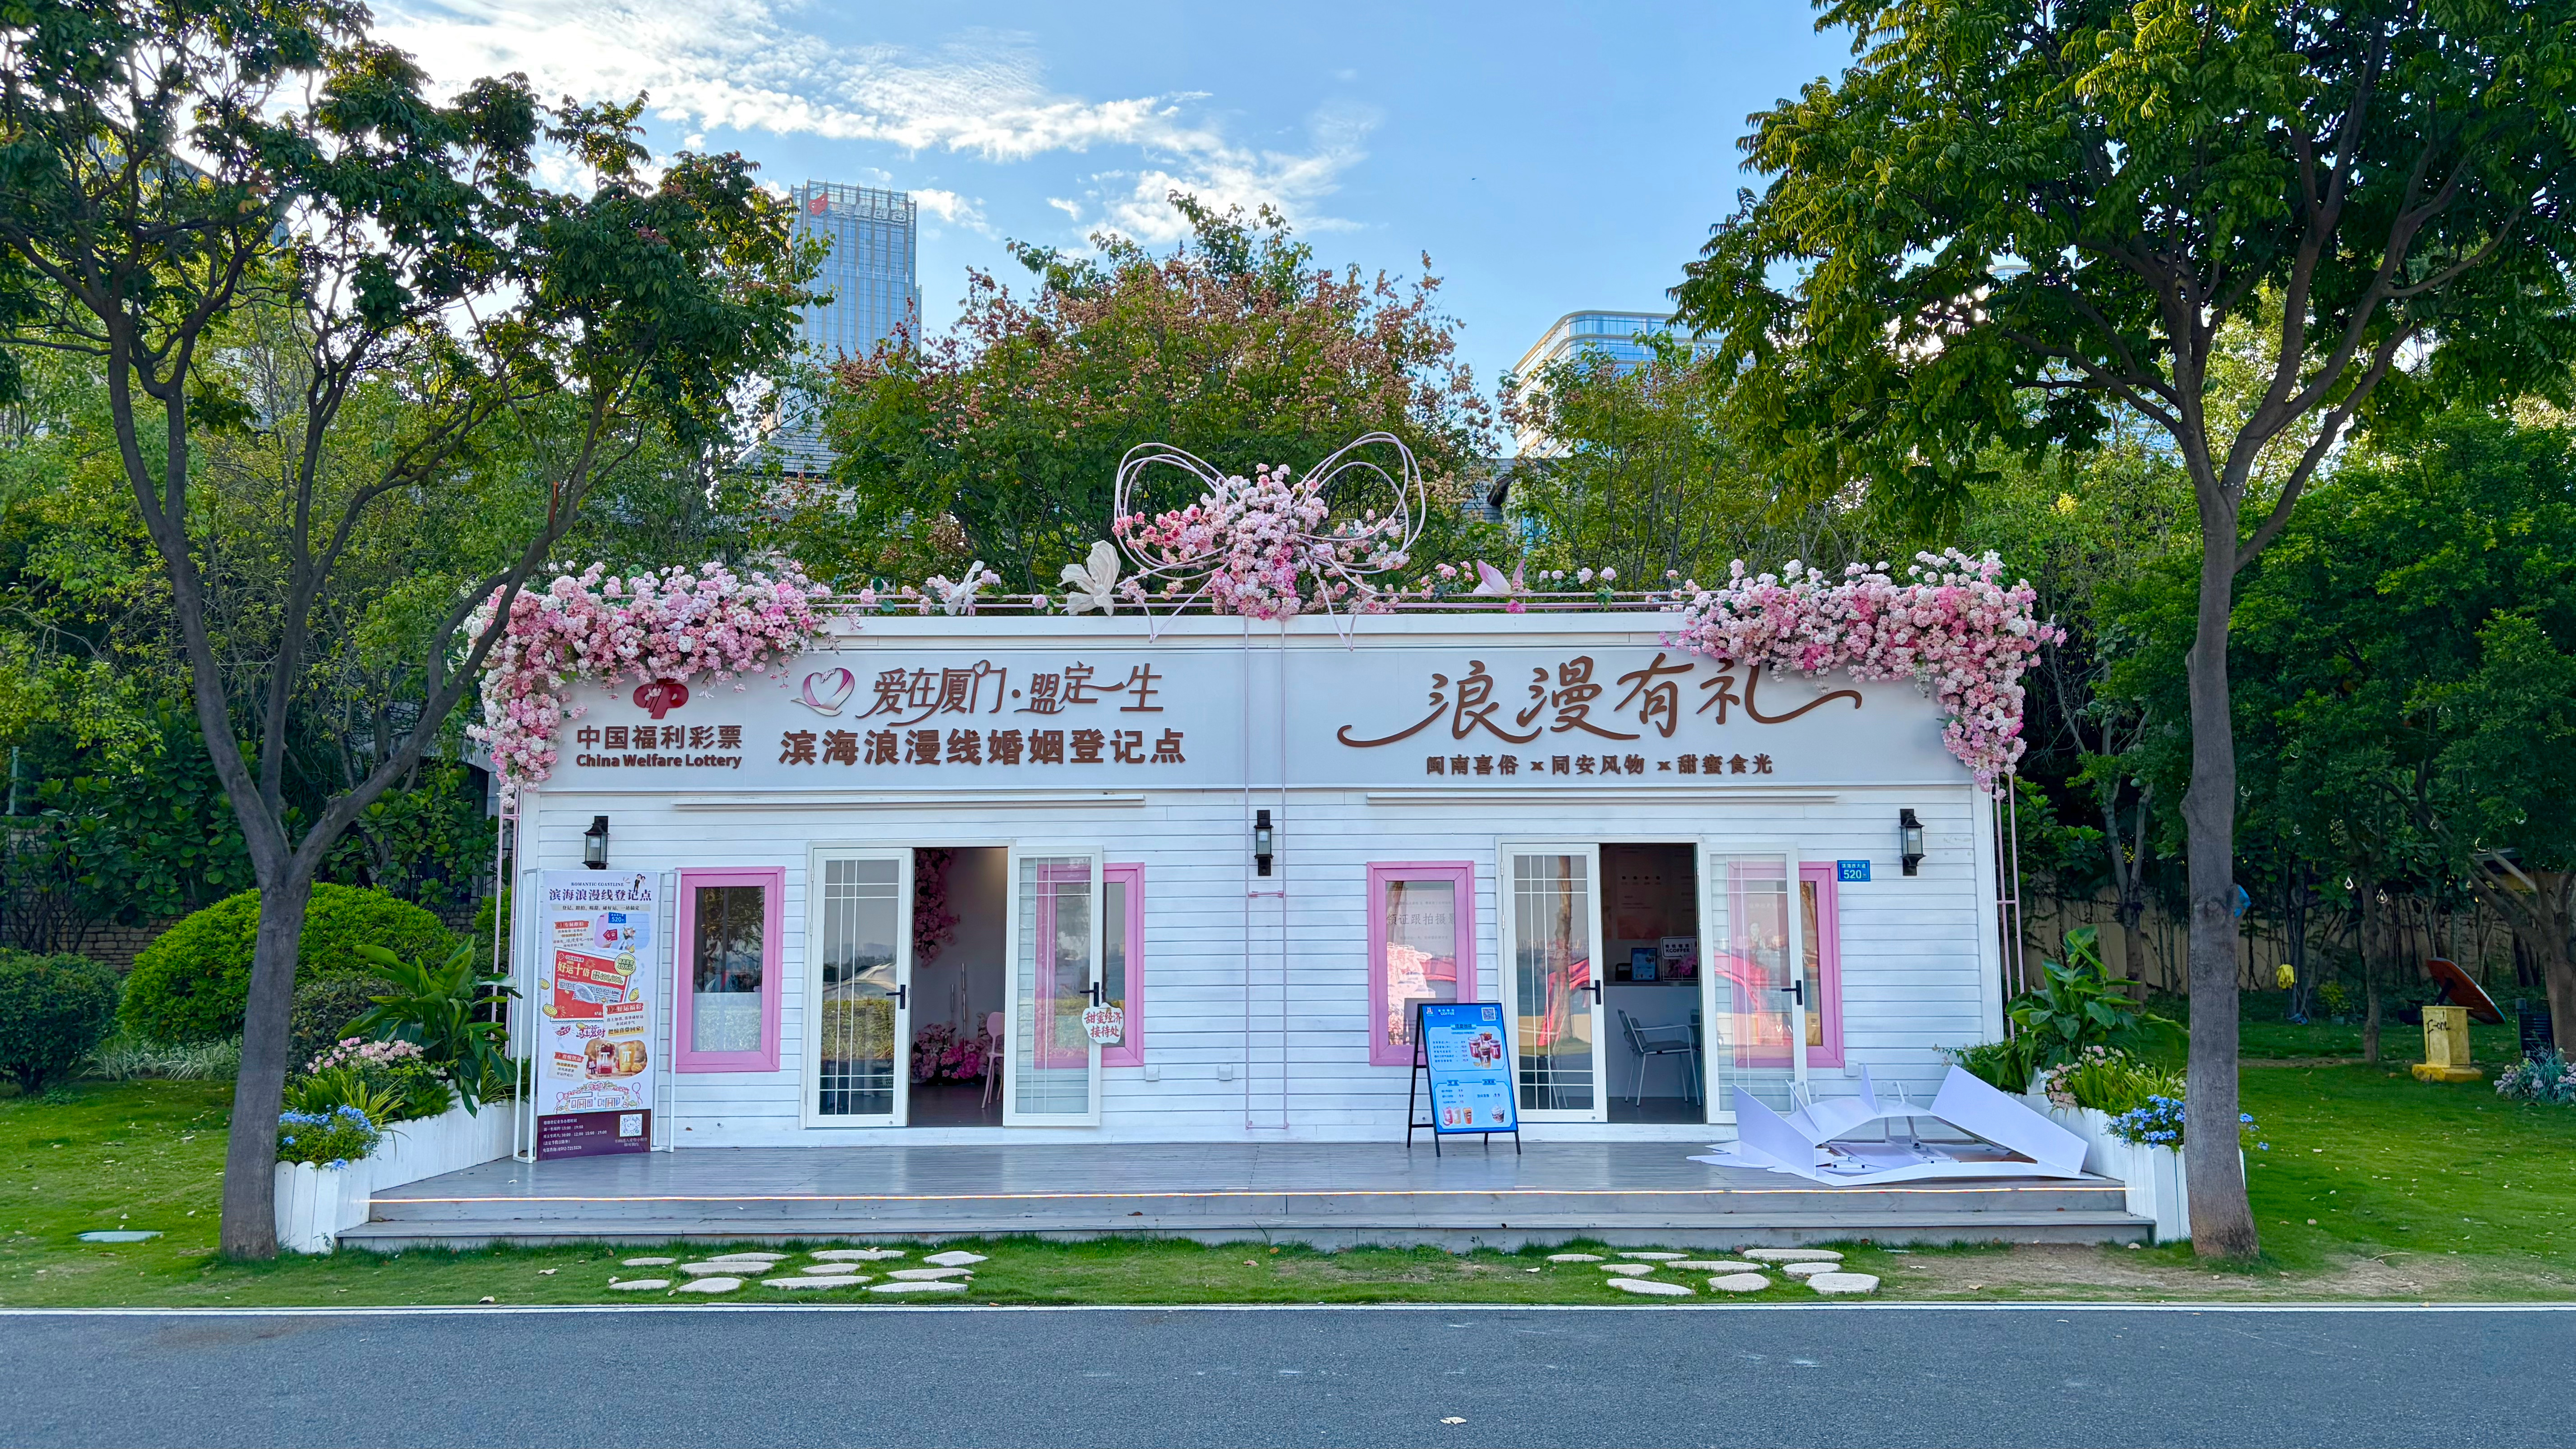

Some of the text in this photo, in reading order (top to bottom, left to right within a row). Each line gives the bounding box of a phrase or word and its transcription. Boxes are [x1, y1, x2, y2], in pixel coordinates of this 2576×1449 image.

[1337, 652, 1862, 747] 浪漫有礼
[577, 725, 742, 750] 中国福利彩票
[779, 728, 1186, 766] 滨海浪漫线婚姻登记点
[576, 754, 742, 769] China Welfare Lottery
[549, 888, 652, 901] 滨海浪漫线登记点
[557, 961, 590, 977] 好运十倍
[1084, 1011, 1122, 1025] 甜蜜经济
[1090, 1025, 1120, 1038] 接待处
